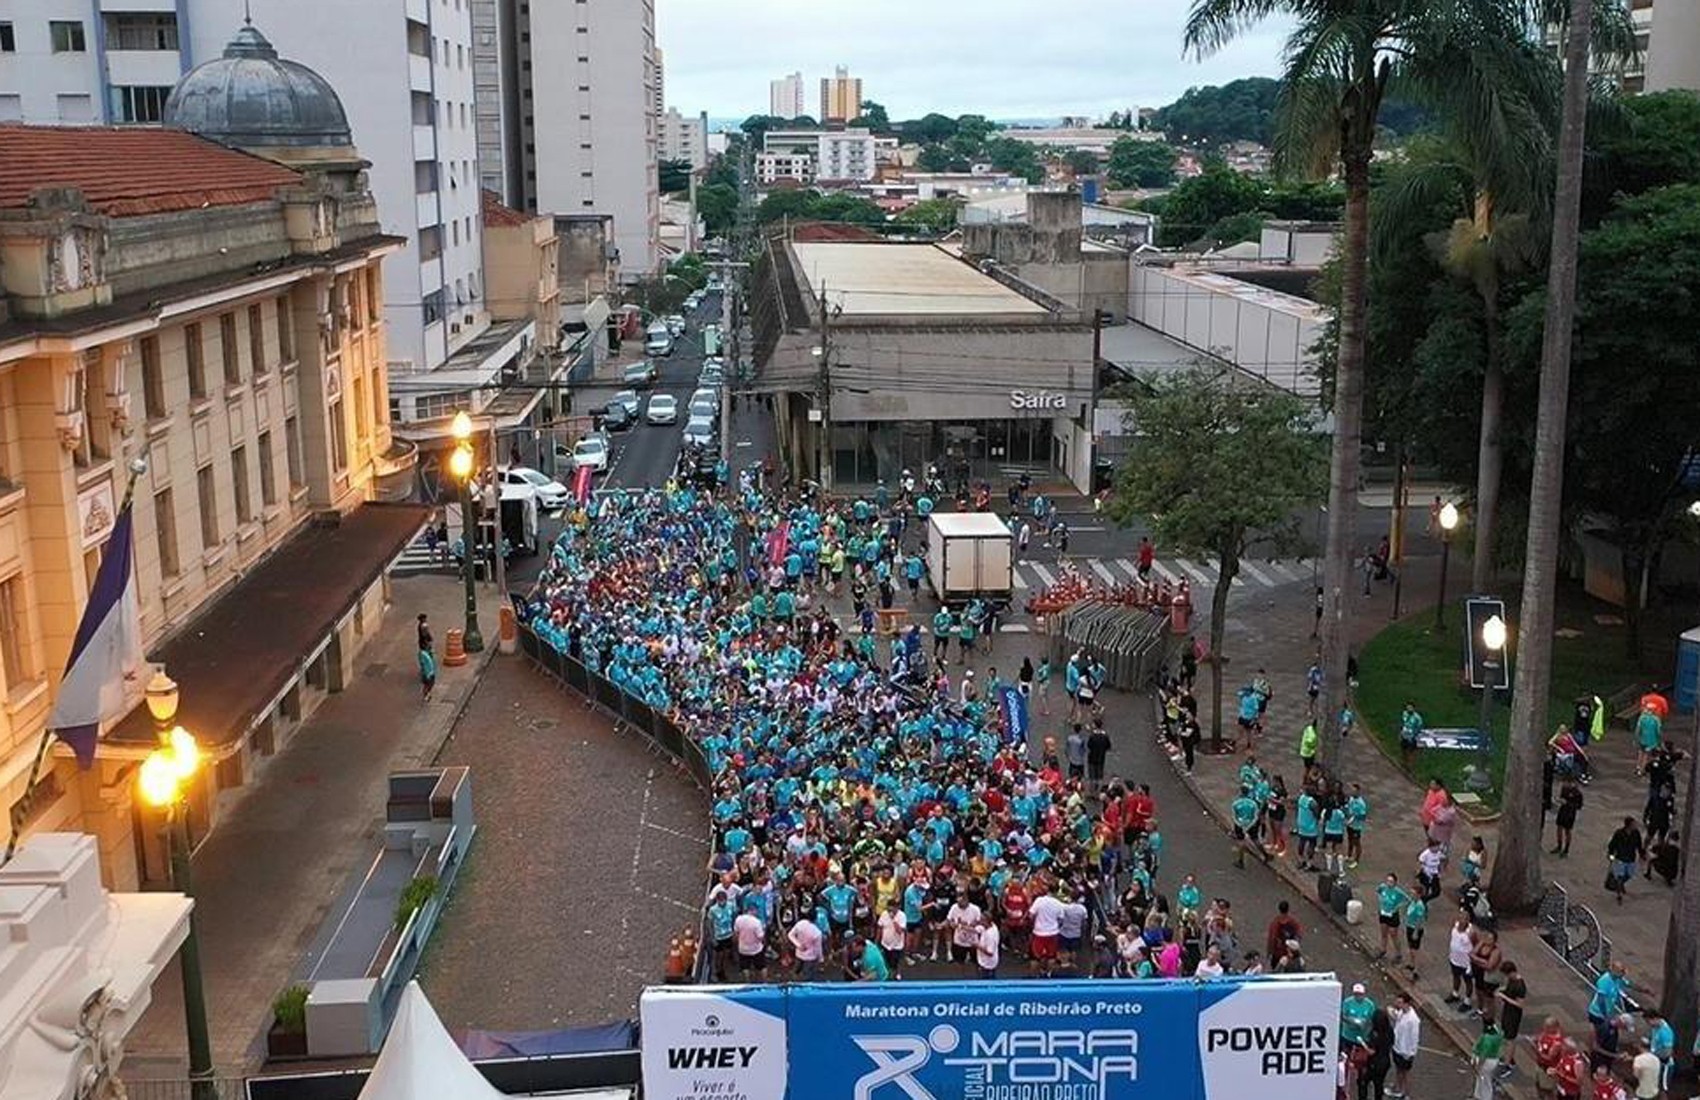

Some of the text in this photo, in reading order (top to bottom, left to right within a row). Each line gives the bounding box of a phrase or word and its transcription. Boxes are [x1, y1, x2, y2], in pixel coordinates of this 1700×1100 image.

[845, 1001, 1142, 1018] Maratona Oficial de Ribeirão Preto
[971, 1029, 1138, 1056] MARA
[1208, 1026, 1327, 1053] POWER
[668, 1046, 758, 1069] WHEY
[1262, 1050, 1326, 1075] ADE
[944, 1055, 1138, 1086] TONA
[693, 1080, 723, 1094] Viver
